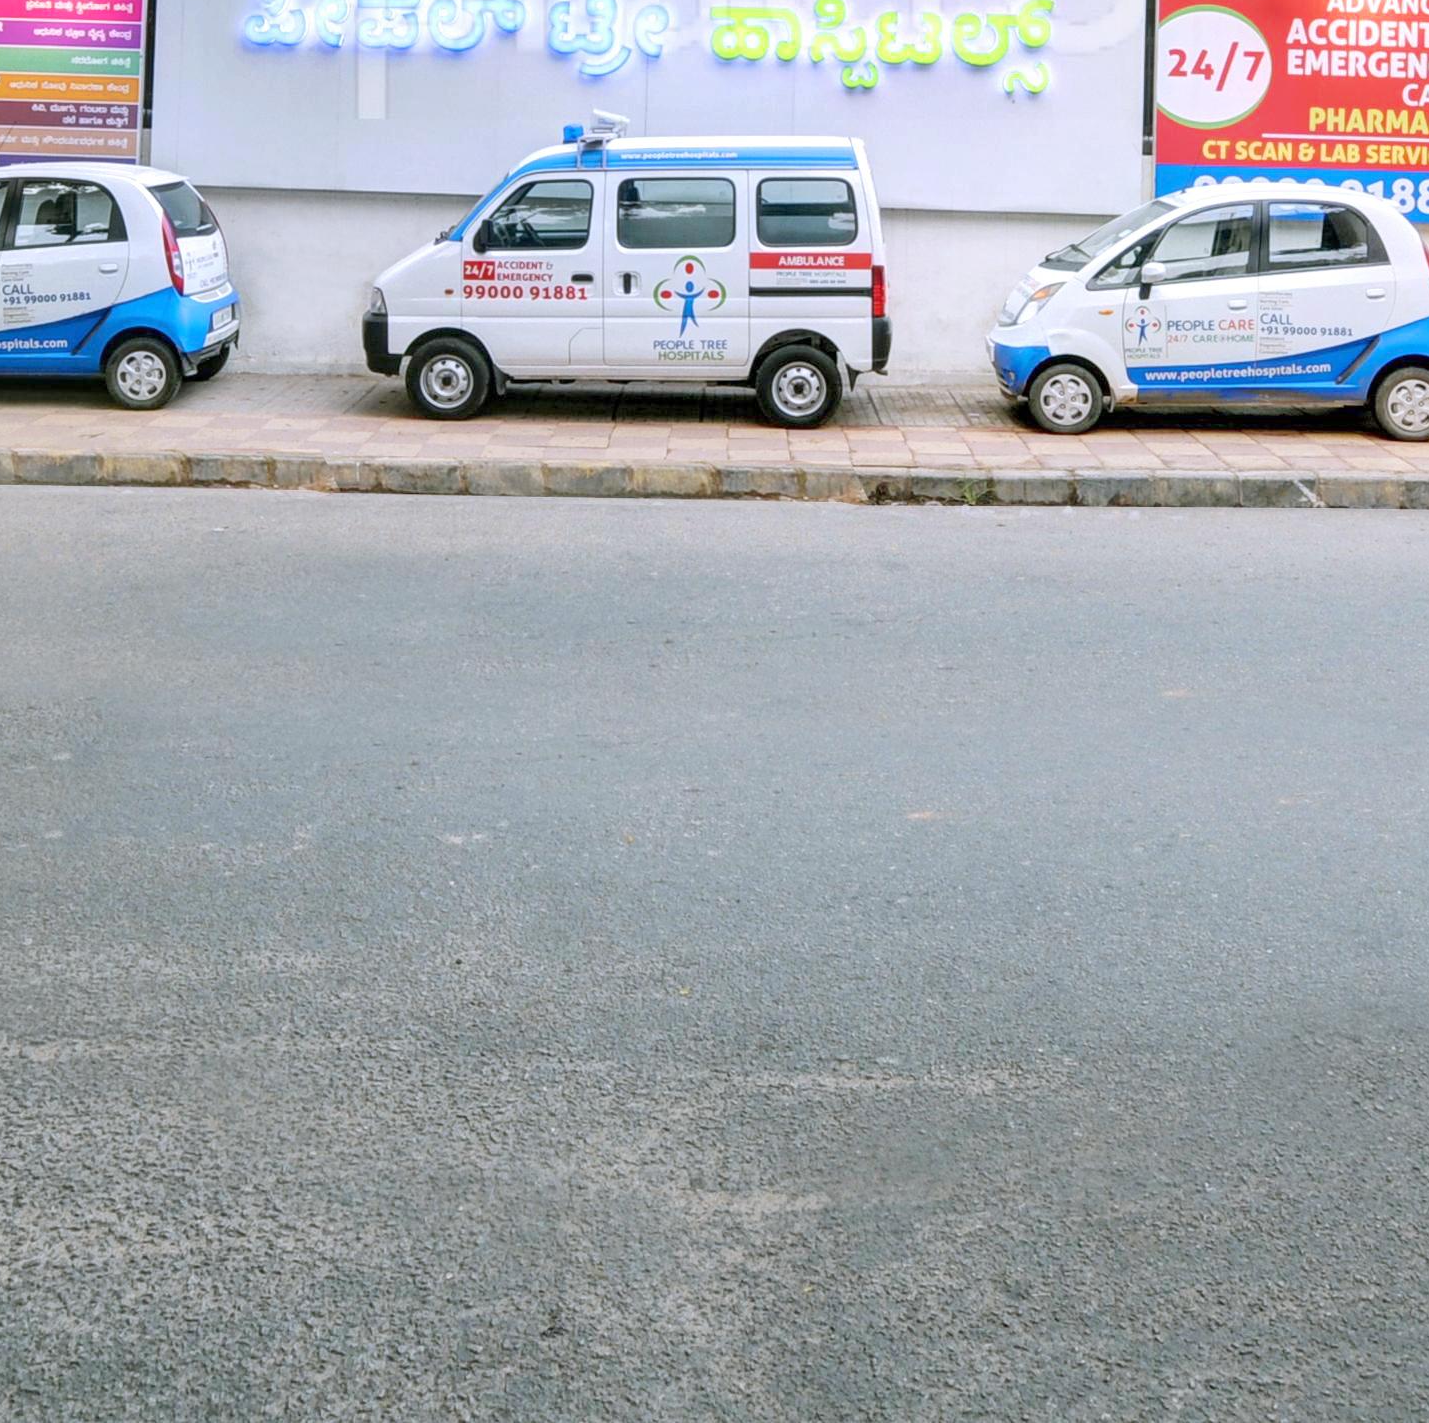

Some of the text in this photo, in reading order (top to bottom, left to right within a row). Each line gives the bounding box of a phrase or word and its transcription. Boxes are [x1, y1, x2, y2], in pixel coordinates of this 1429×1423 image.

[1168, 41, 1265, 91] 24/7
[1202, 140, 1230, 160] CT
[1235, 142, 1292, 161] SCAN
[1298, 143, 1315, 162] &
[1320, 144, 1360, 164] LAB
[778, 256, 845, 266] AMBULANCE
[464, 262, 494, 278] 24/7
[497, 261, 543, 270] ACCIDENT
[497, 273, 553, 282] EMERGENCY
[2, 284, 34, 295] CALL
[463, 285, 587, 300] 99000 91881
[3, 291, 91, 305] +91 99000 91881
[1167, 319, 1254, 331] PEOPLE CARE
[1260, 313, 1292, 325] CALL
[1261, 326, 1353, 337] +91 99000 91881
[653, 340, 728, 350] PEOPLE TREE
[1167, 335, 1188, 343] 24/7
[658, 351, 724, 360] HOSPITALS
[1145, 361, 1332, 382] www.peopletreehospitals.com
